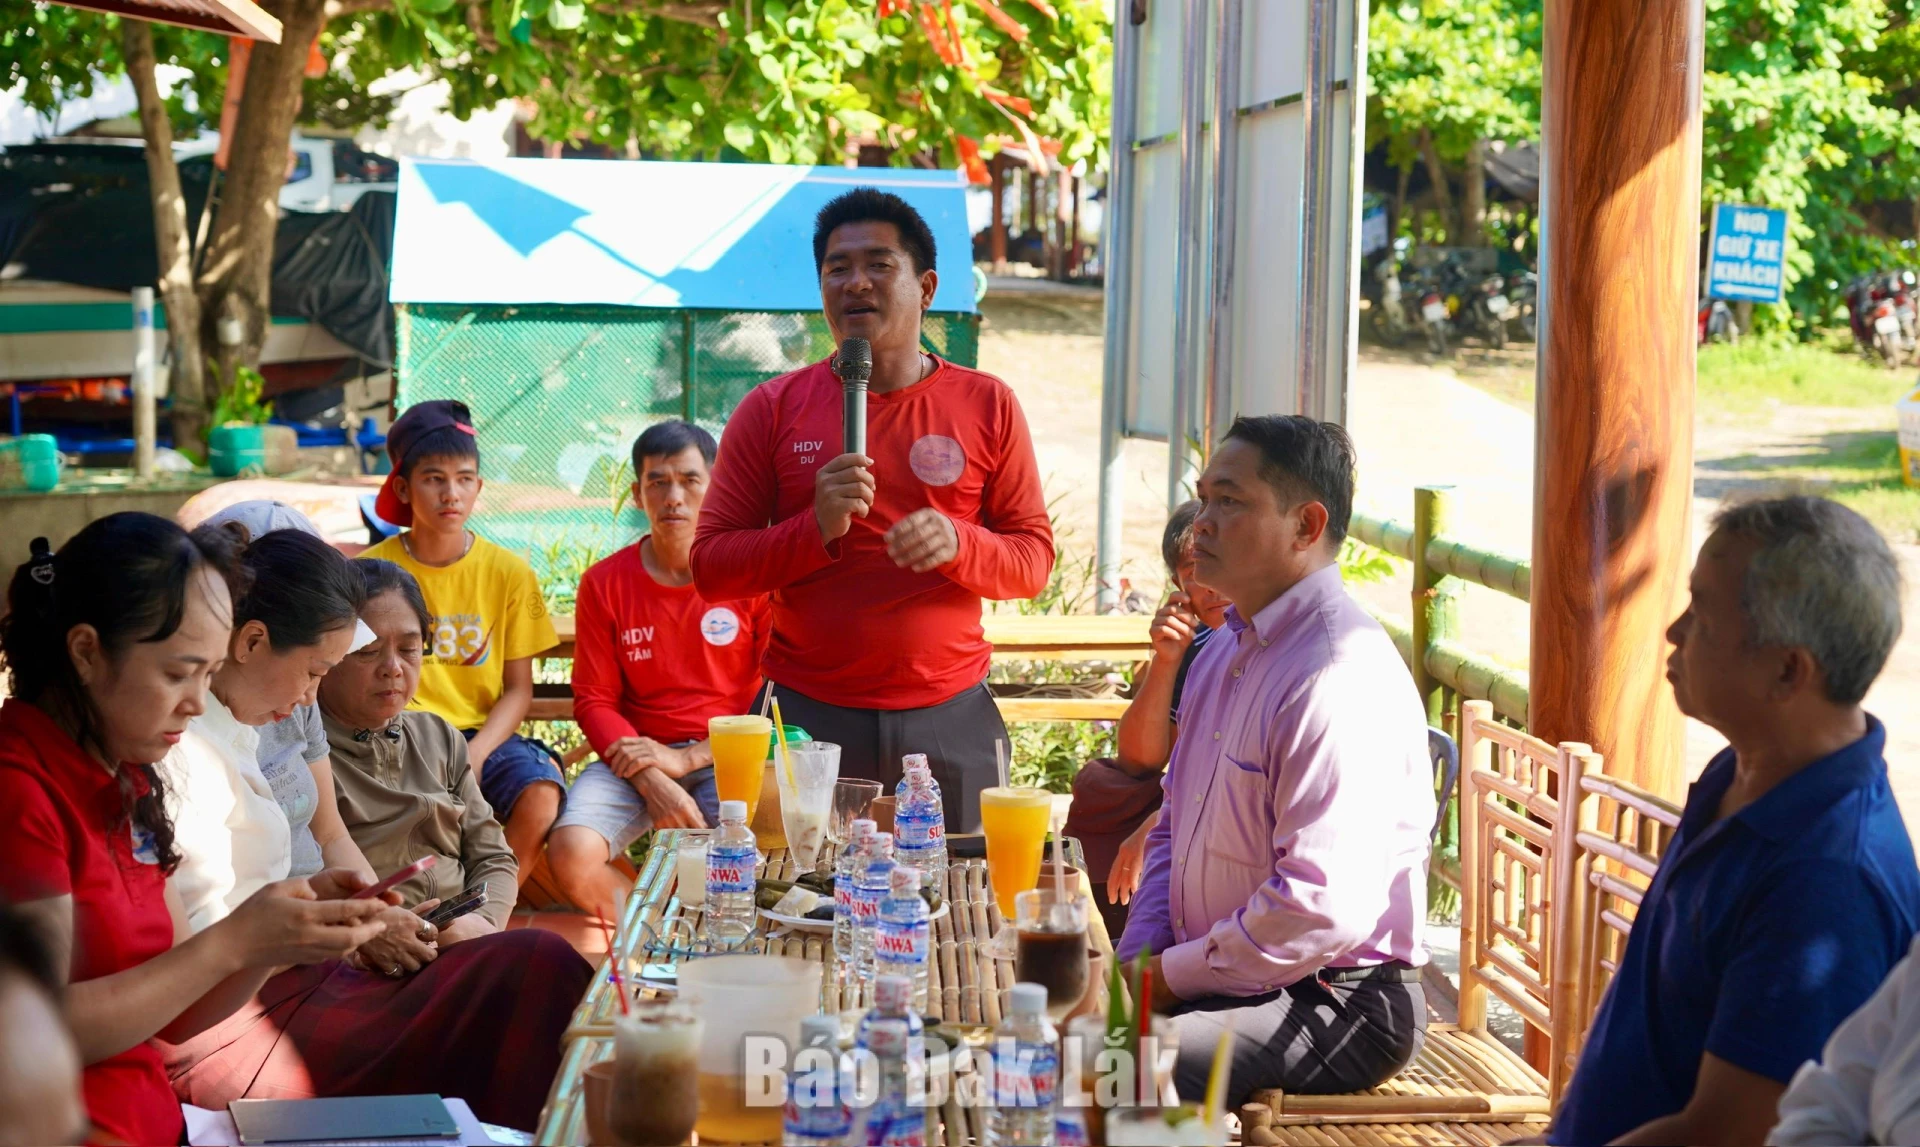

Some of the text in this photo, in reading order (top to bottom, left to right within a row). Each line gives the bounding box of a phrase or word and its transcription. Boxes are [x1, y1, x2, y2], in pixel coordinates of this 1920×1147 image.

[1753, 238, 1780, 261] XE
[1714, 259, 1780, 287] KHÁCH
[793, 440, 823, 453] HDV
[621, 625, 655, 646] HDV
[626, 647, 653, 662] TÂM
